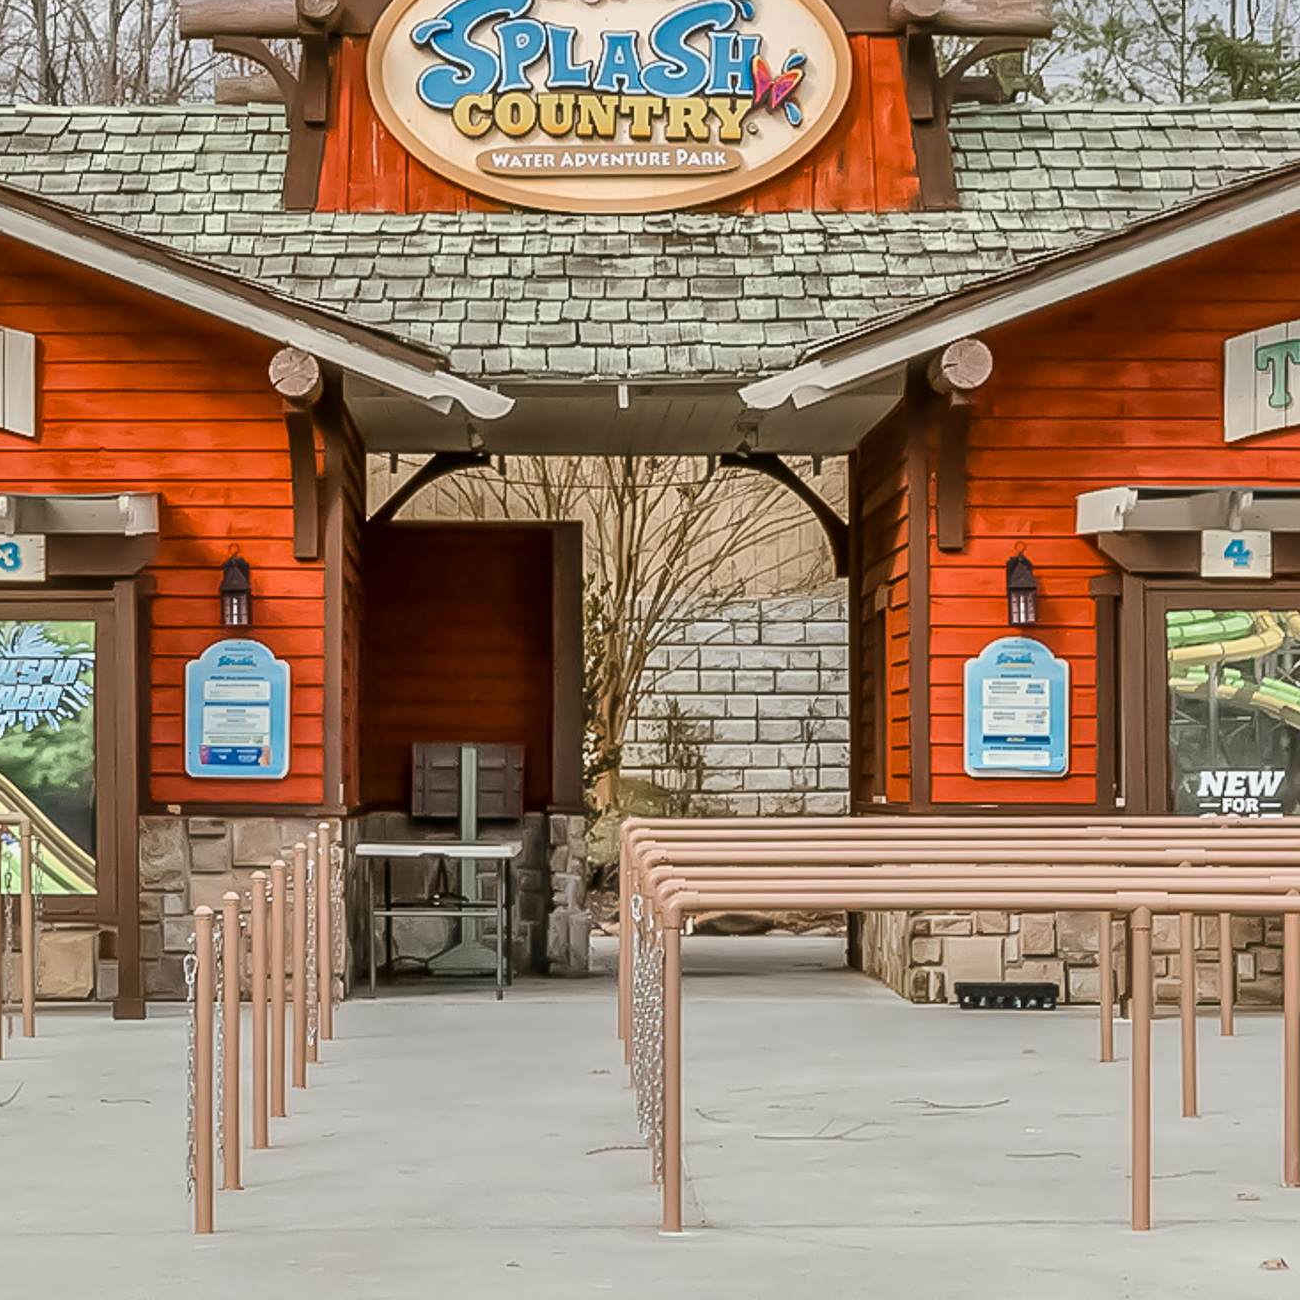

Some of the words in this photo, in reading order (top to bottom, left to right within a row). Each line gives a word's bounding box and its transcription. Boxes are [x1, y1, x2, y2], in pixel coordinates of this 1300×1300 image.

[452, 92, 753, 141] COUNTRY
[491, 152, 555, 168] WATER
[560, 150, 671, 168] ADVENTURE
[675, 149, 727, 167] PARK
[1223, 539, 1251, 567] 4
[1197, 770, 1286, 797] NEW
[1221, 797, 1260, 813] FOR
